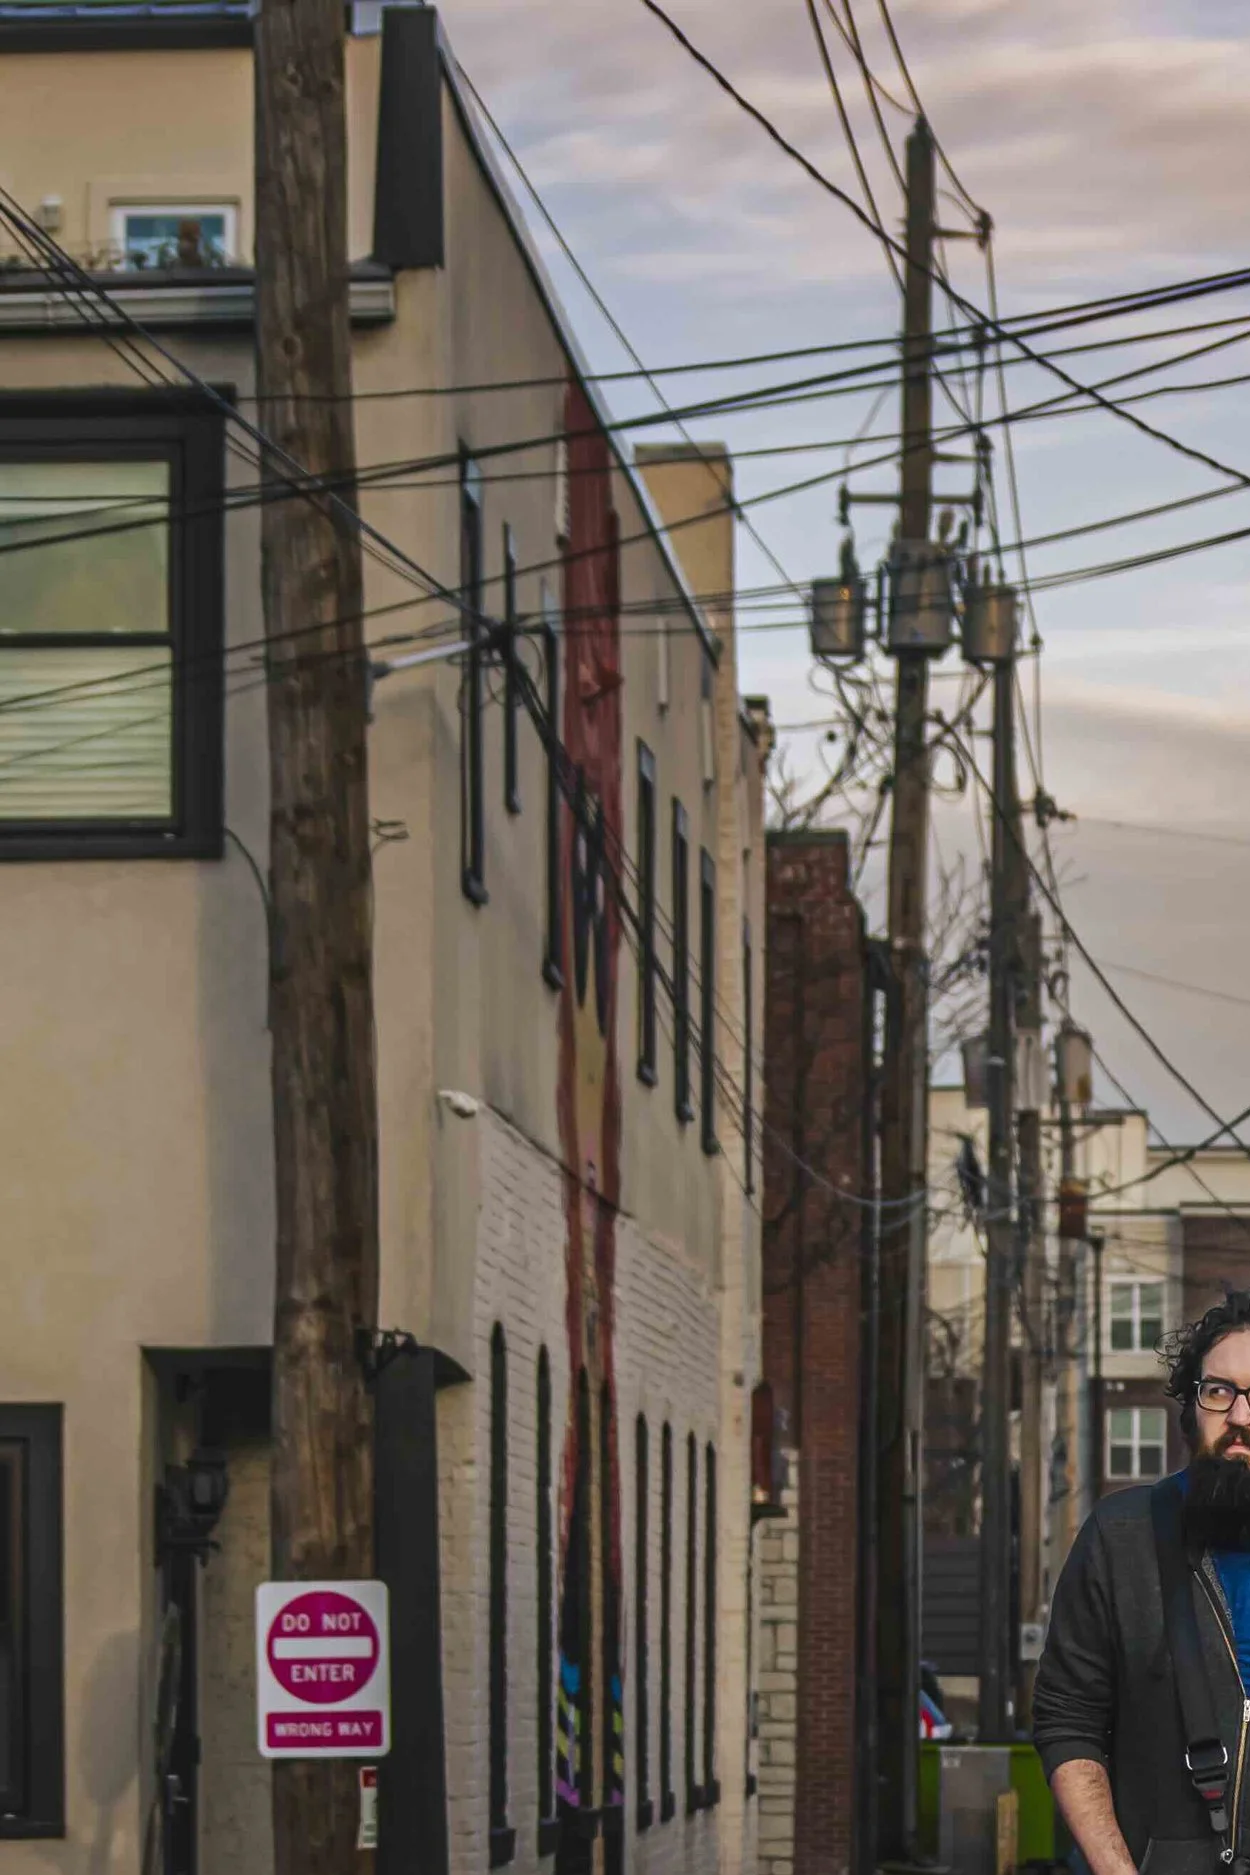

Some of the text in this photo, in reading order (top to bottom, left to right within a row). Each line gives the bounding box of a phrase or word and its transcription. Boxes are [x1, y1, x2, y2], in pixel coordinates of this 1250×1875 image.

[282, 1612, 362, 1632] DO NOT
[291, 1663, 355, 1683] ENTER
[274, 1721, 374, 1738] WRONG WAY
